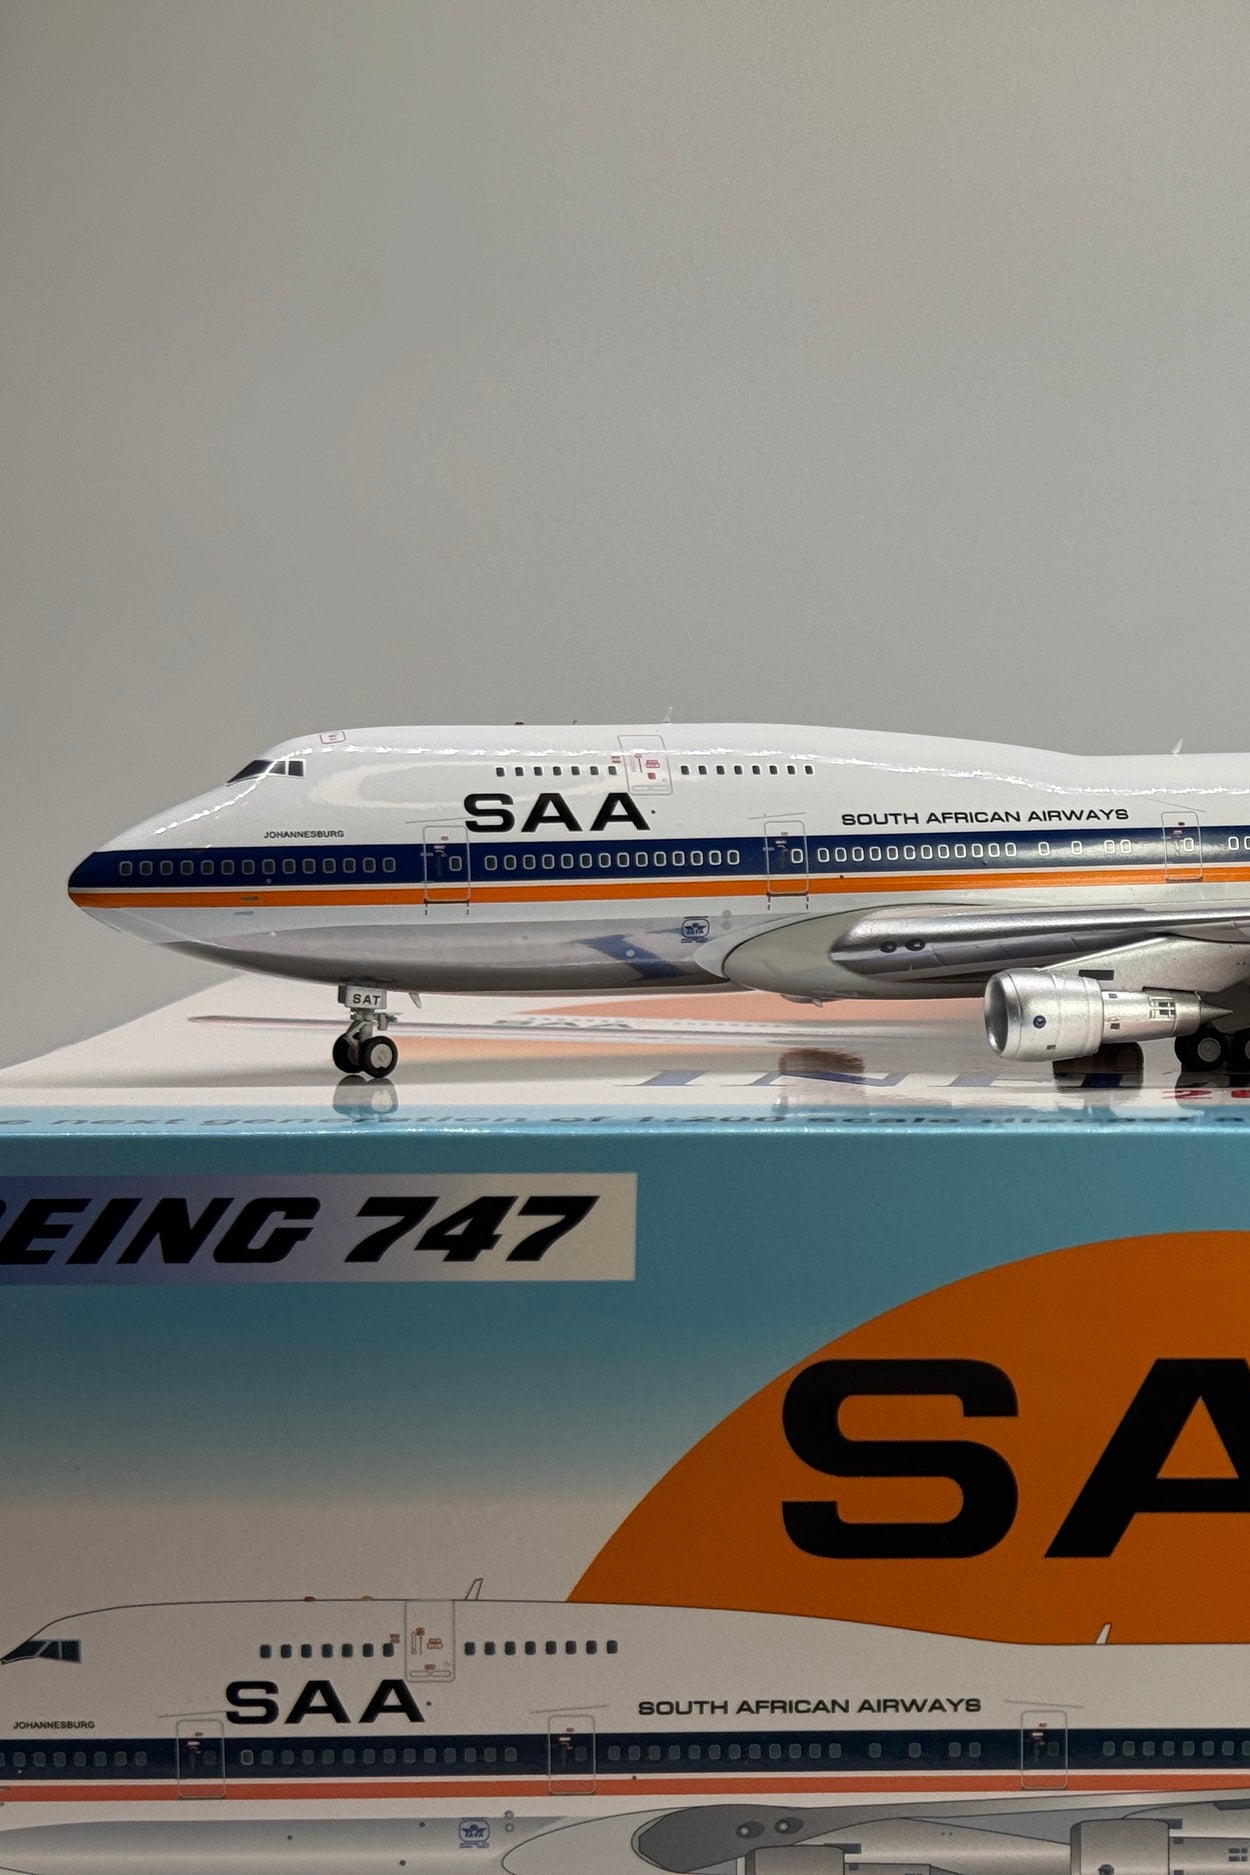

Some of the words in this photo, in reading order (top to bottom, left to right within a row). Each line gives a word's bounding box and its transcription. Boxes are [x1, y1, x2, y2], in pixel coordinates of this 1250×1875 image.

[464, 793, 651, 832] SAA
[841, 812, 919, 826] SOUTH
[926, 811, 1022, 825] AFRICAN
[1027, 809, 1129, 823] AIRWAYS
[264, 830, 345, 839] JOHANNESBURG
[352, 994, 381, 1006] SAT
[0, 1198, 321, 1264] EING
[344, 1196, 600, 1263] 747
[226, 1679, 425, 1724] SAA
[638, 1701, 728, 1715] SOUTH
[736, 1700, 850, 1715] AFRICAN
[857, 1698, 982, 1713] AIRWAYS
[13, 1720, 96, 1730] JOHANNESBURG
